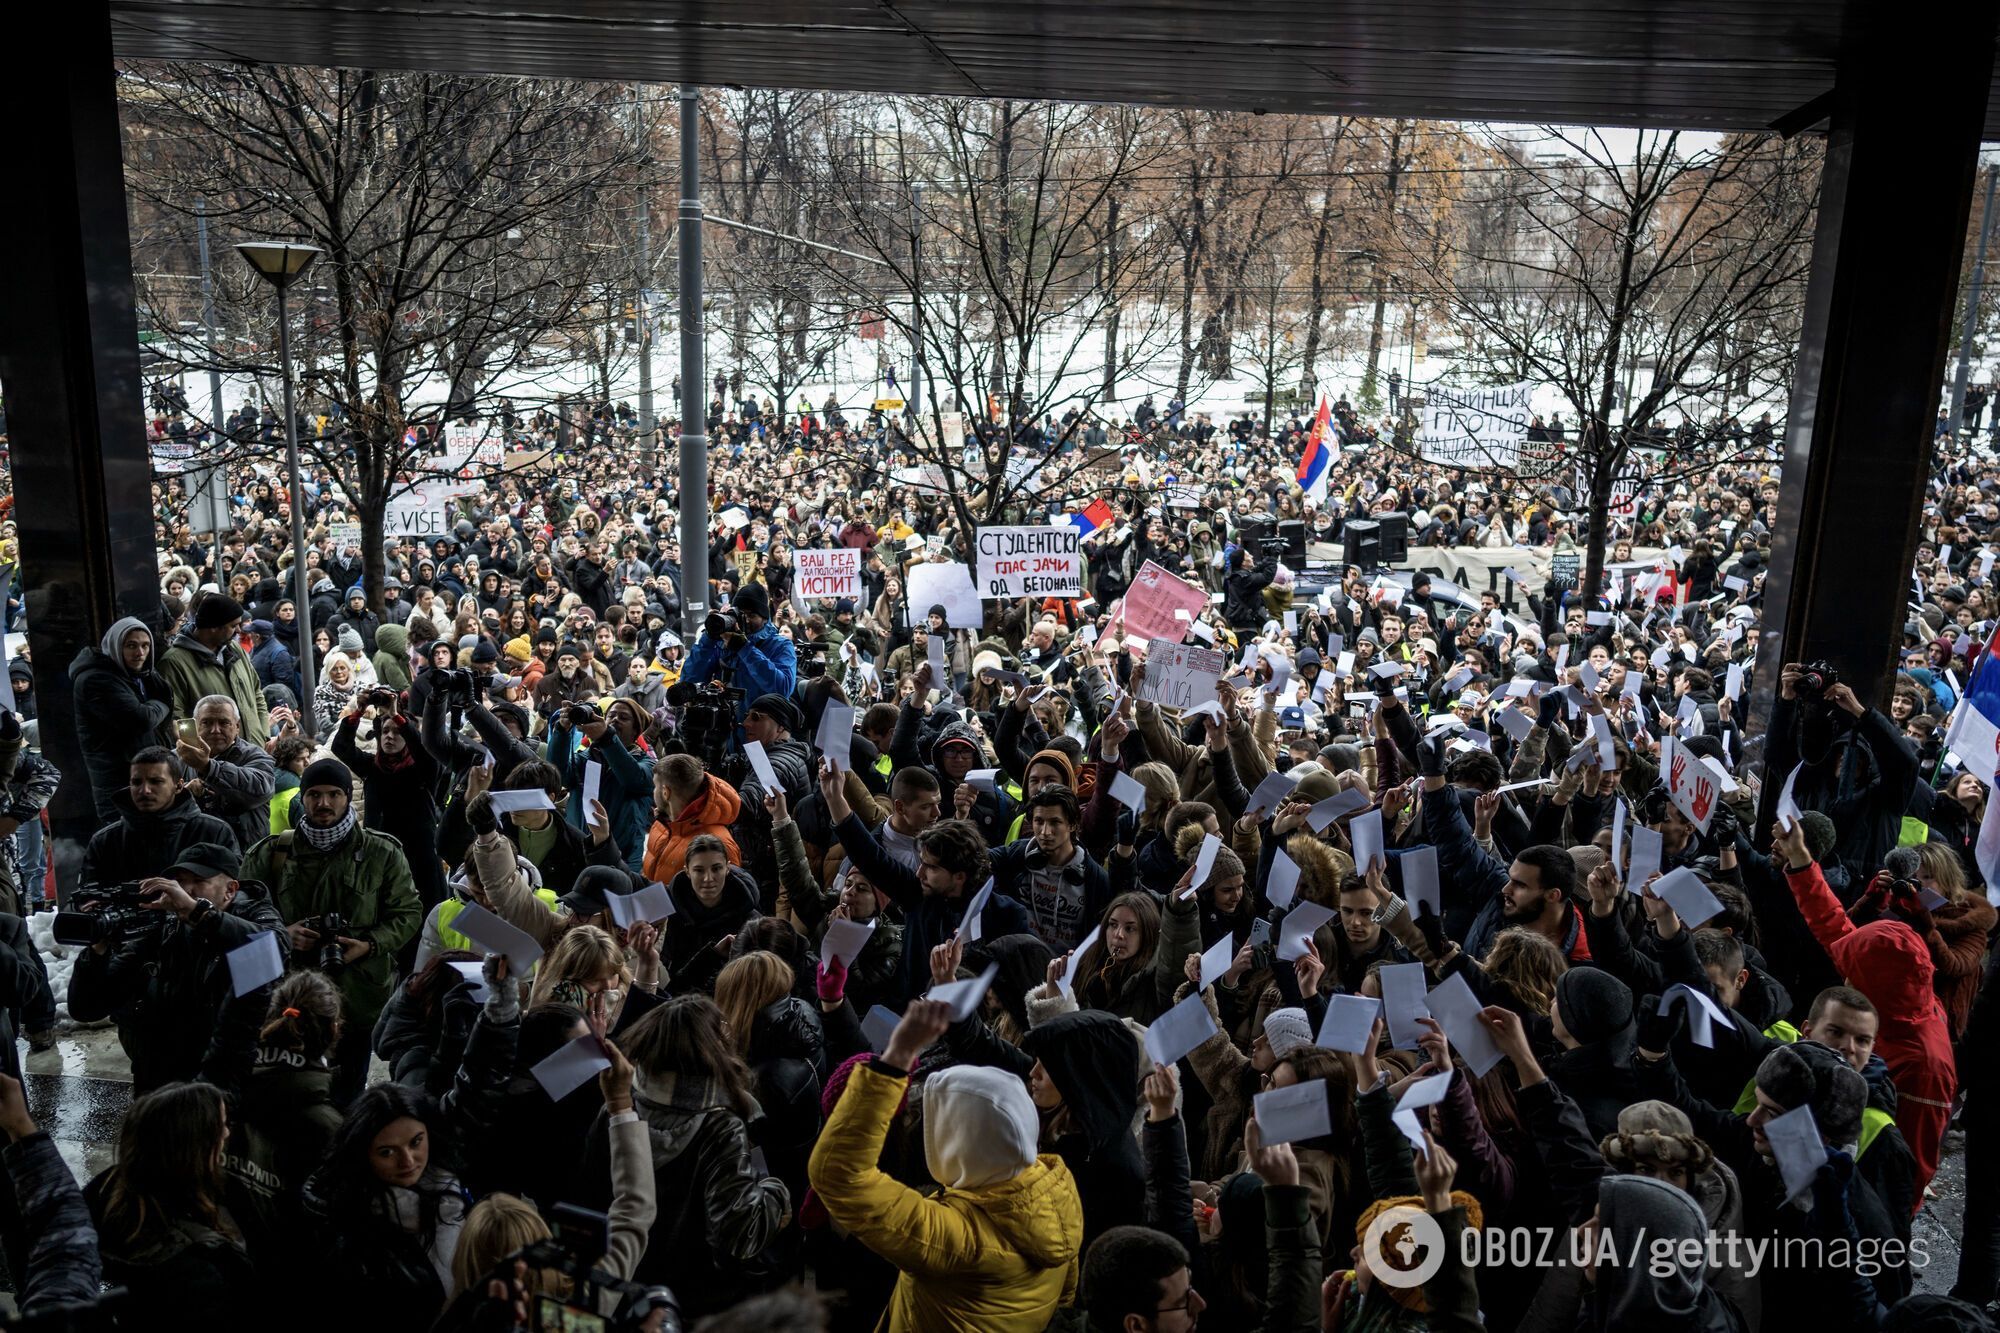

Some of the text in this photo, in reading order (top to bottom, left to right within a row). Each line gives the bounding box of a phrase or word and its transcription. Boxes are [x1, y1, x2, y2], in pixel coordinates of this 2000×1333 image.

[1434, 412, 1527, 434] ПРОТИВ
[401, 508, 441, 534] VIŠE
[801, 553, 855, 568] ВАШ РЕД
[995, 557, 1069, 575] ГЛАС ЈАЧИ
[802, 576, 854, 595] ИСПИТ
[990, 576, 1080, 596] ОД БЕТОНА!!!
